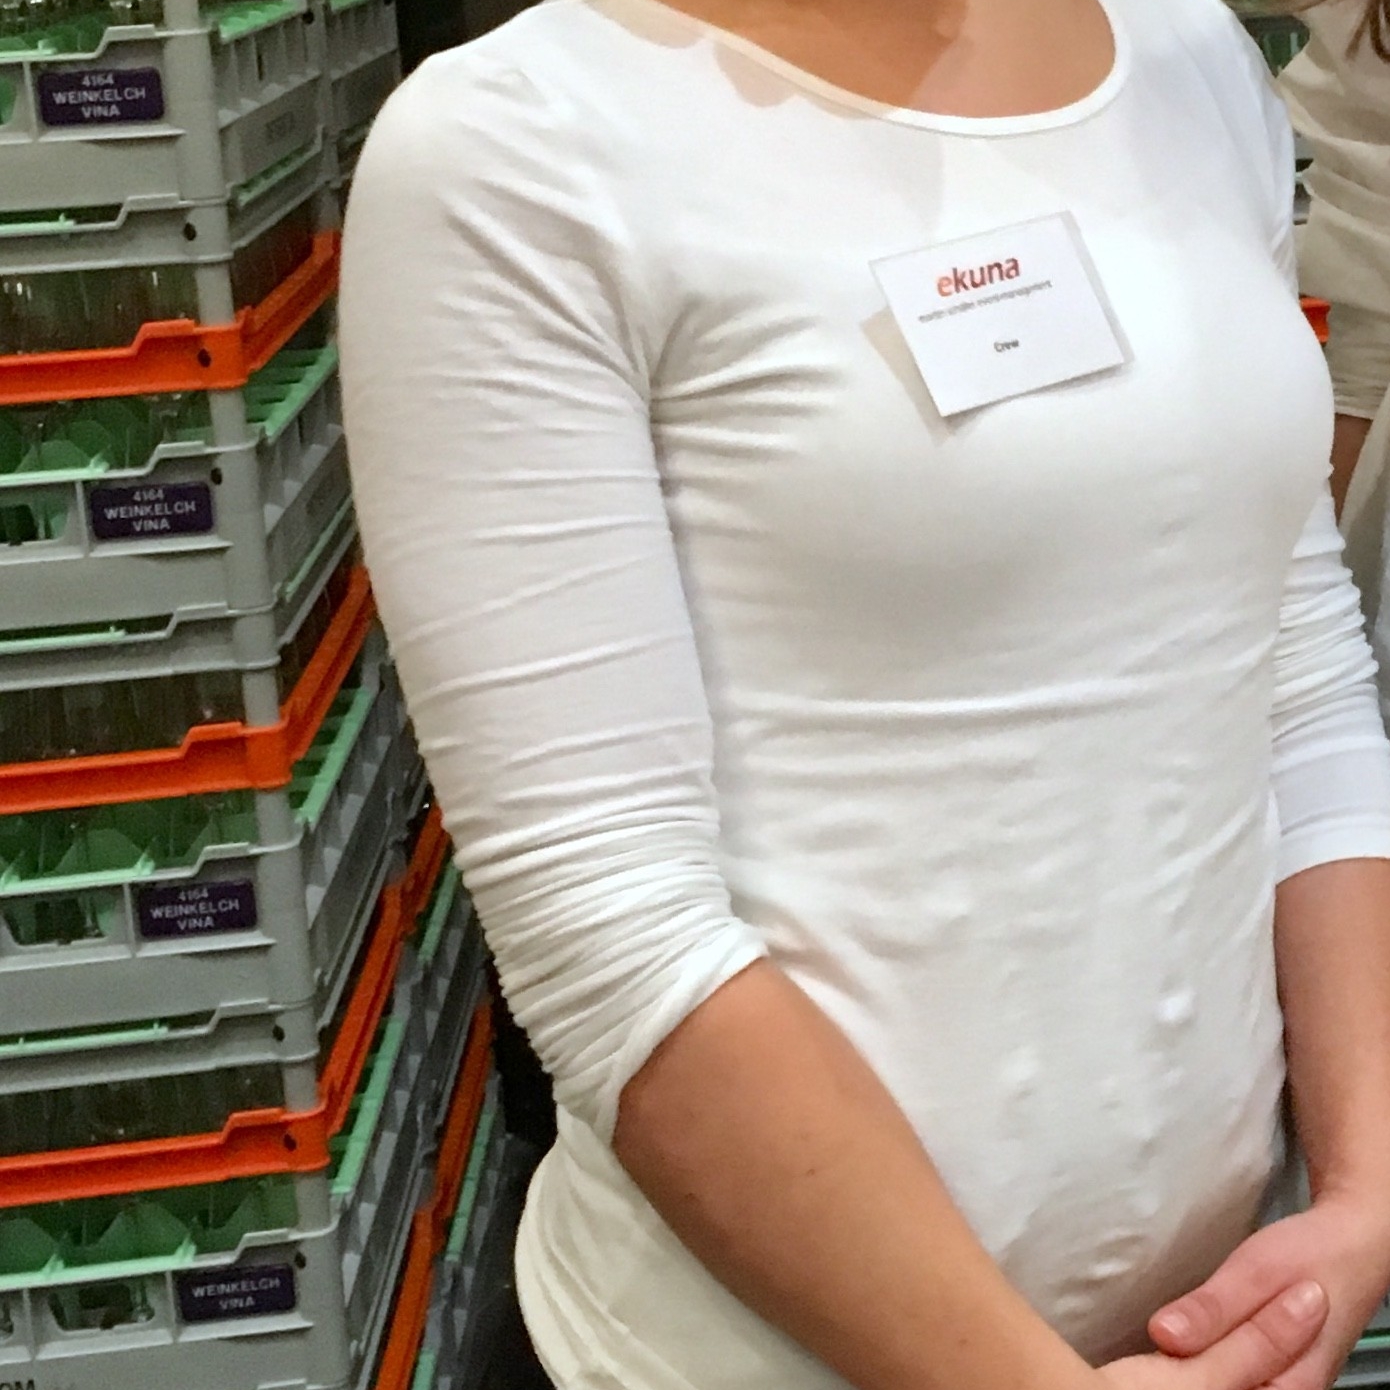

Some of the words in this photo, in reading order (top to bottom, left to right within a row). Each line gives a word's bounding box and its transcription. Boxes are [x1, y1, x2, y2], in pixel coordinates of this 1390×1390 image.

[52, 87, 146, 104] WEINKELCH
[81, 104, 121, 118] VINA
[936, 257, 1020, 297] ekuna
[103, 500, 196, 520] WEINKELCH
[132, 518, 171, 532] VINA
[150, 899, 240, 919] WEINKELCH
[177, 916, 215, 930] VINA
[192, 1277, 280, 1298] WEINKELCH
